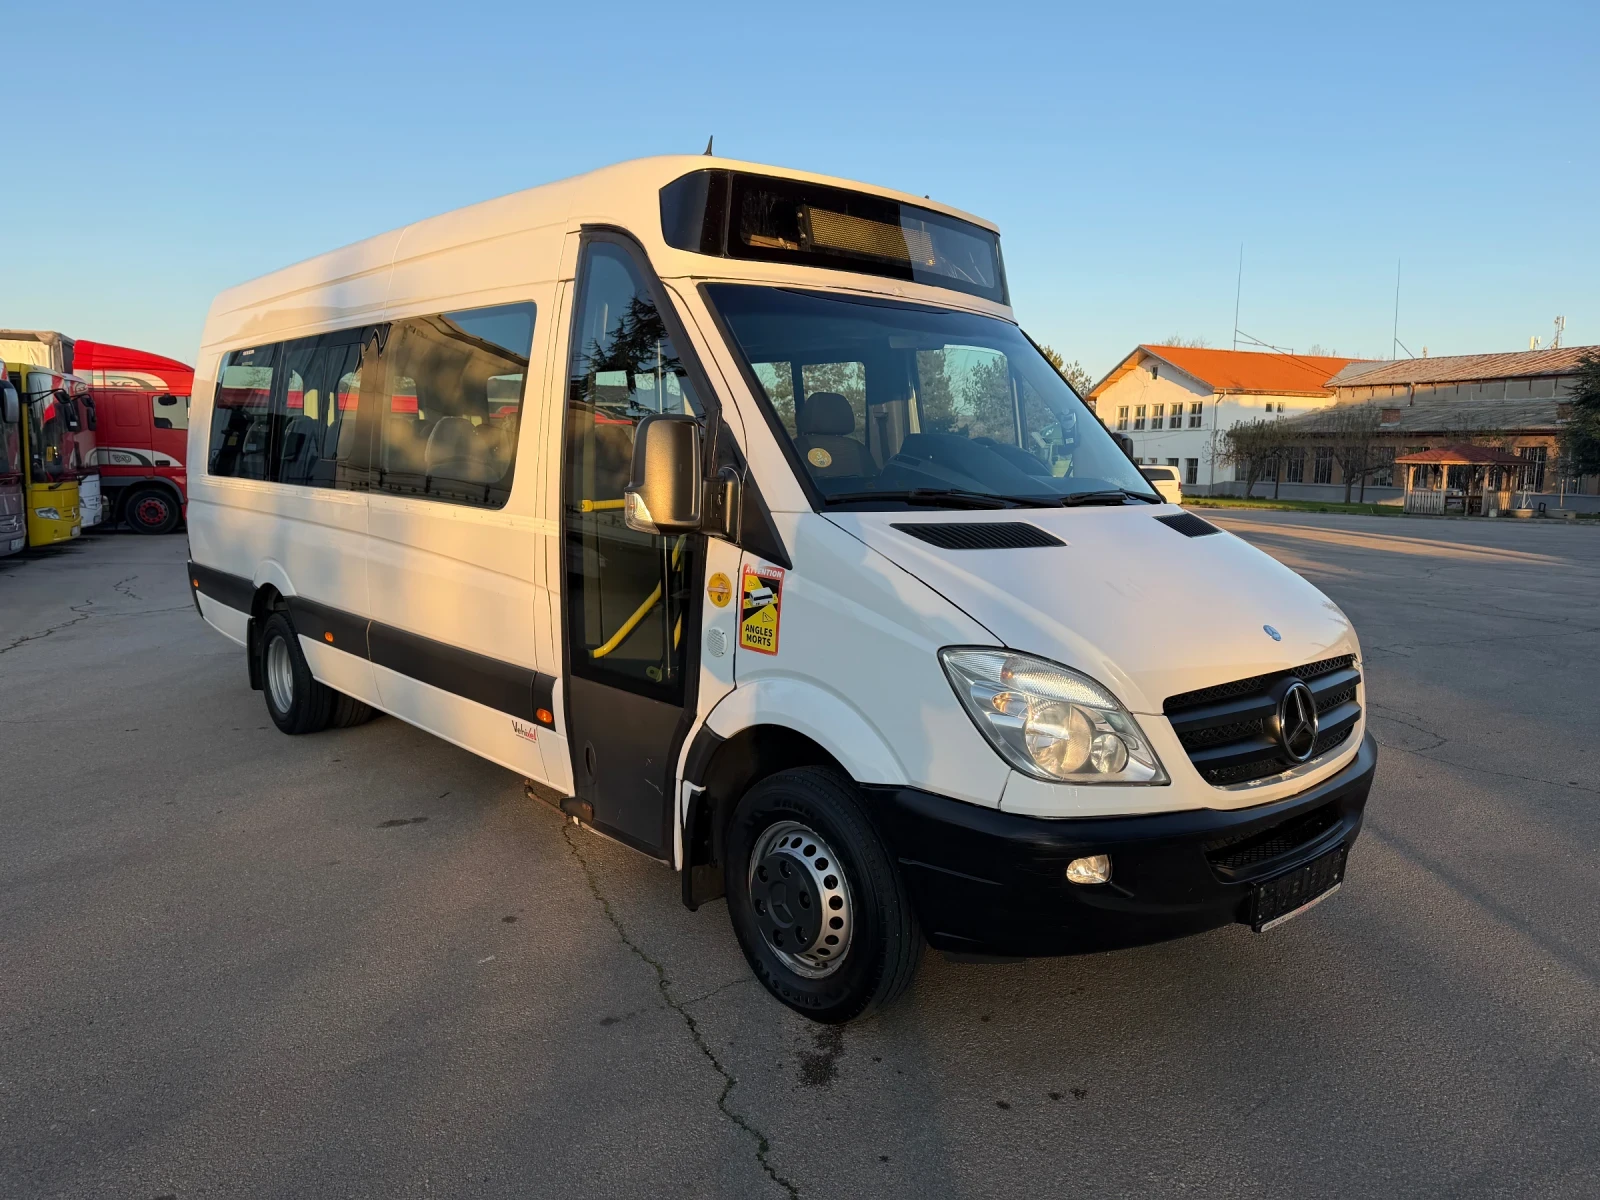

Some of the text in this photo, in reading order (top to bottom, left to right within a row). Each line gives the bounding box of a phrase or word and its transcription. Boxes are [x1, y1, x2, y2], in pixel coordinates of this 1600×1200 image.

[745, 565, 783, 578] ATTENTION
[745, 624, 773, 637] ANGLES
[746, 634, 771, 647] MORTS
